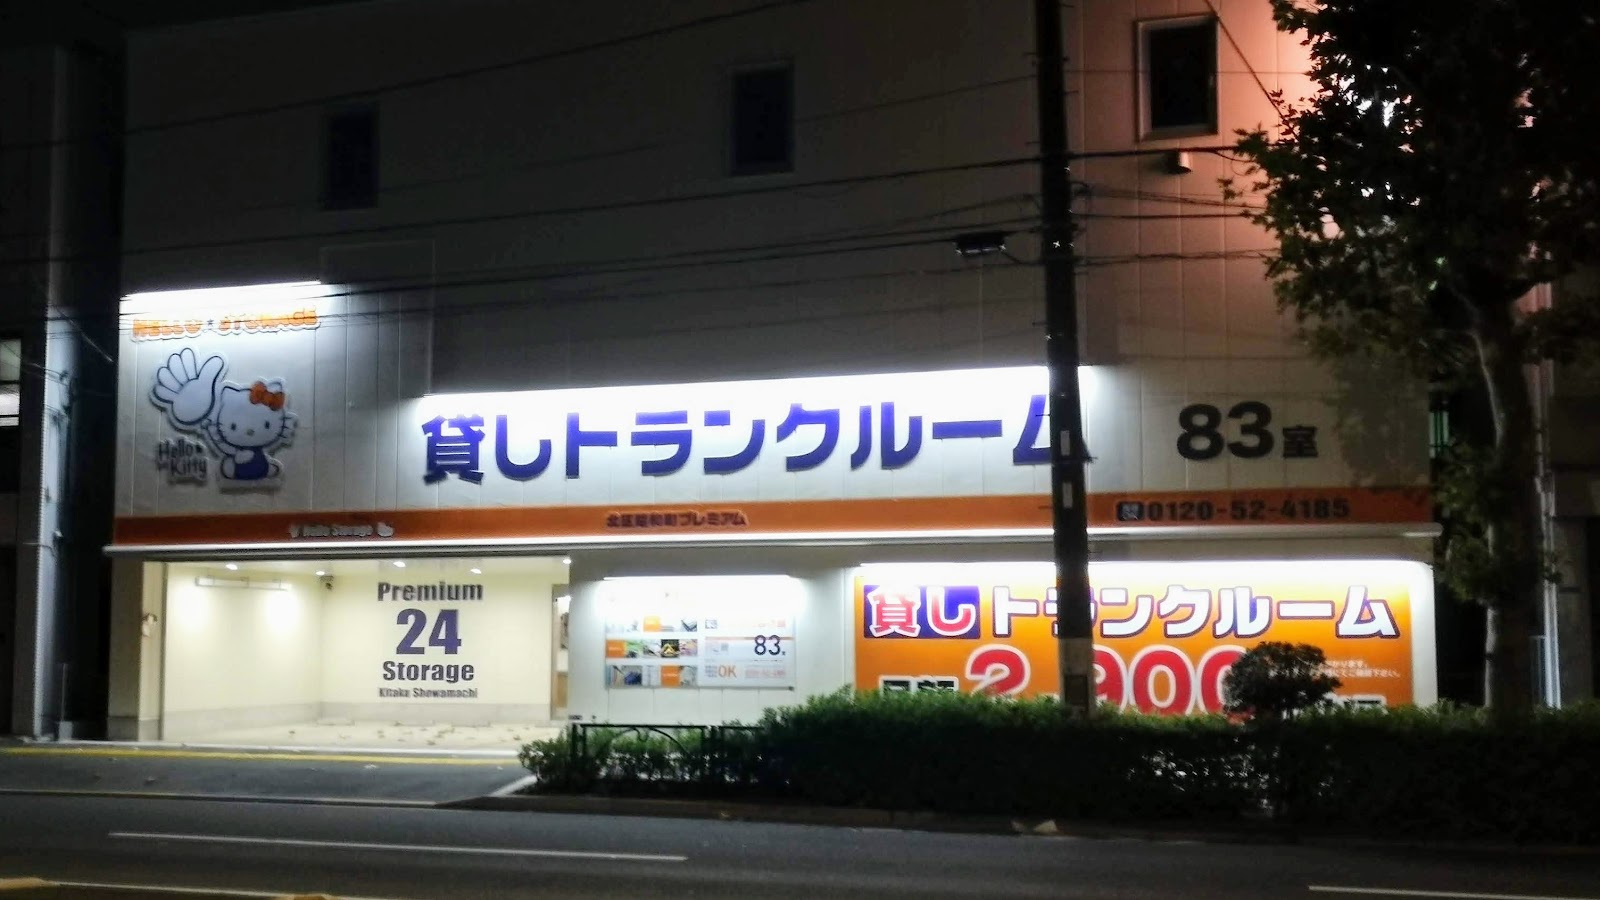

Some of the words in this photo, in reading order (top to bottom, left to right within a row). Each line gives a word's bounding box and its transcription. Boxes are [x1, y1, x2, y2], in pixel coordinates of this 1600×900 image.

[422, 393, 1092, 485] 貸しトランクルーム
[377, 581, 484, 602] Premium
[396, 608, 462, 655] 24
[383, 661, 475, 684] Storage
